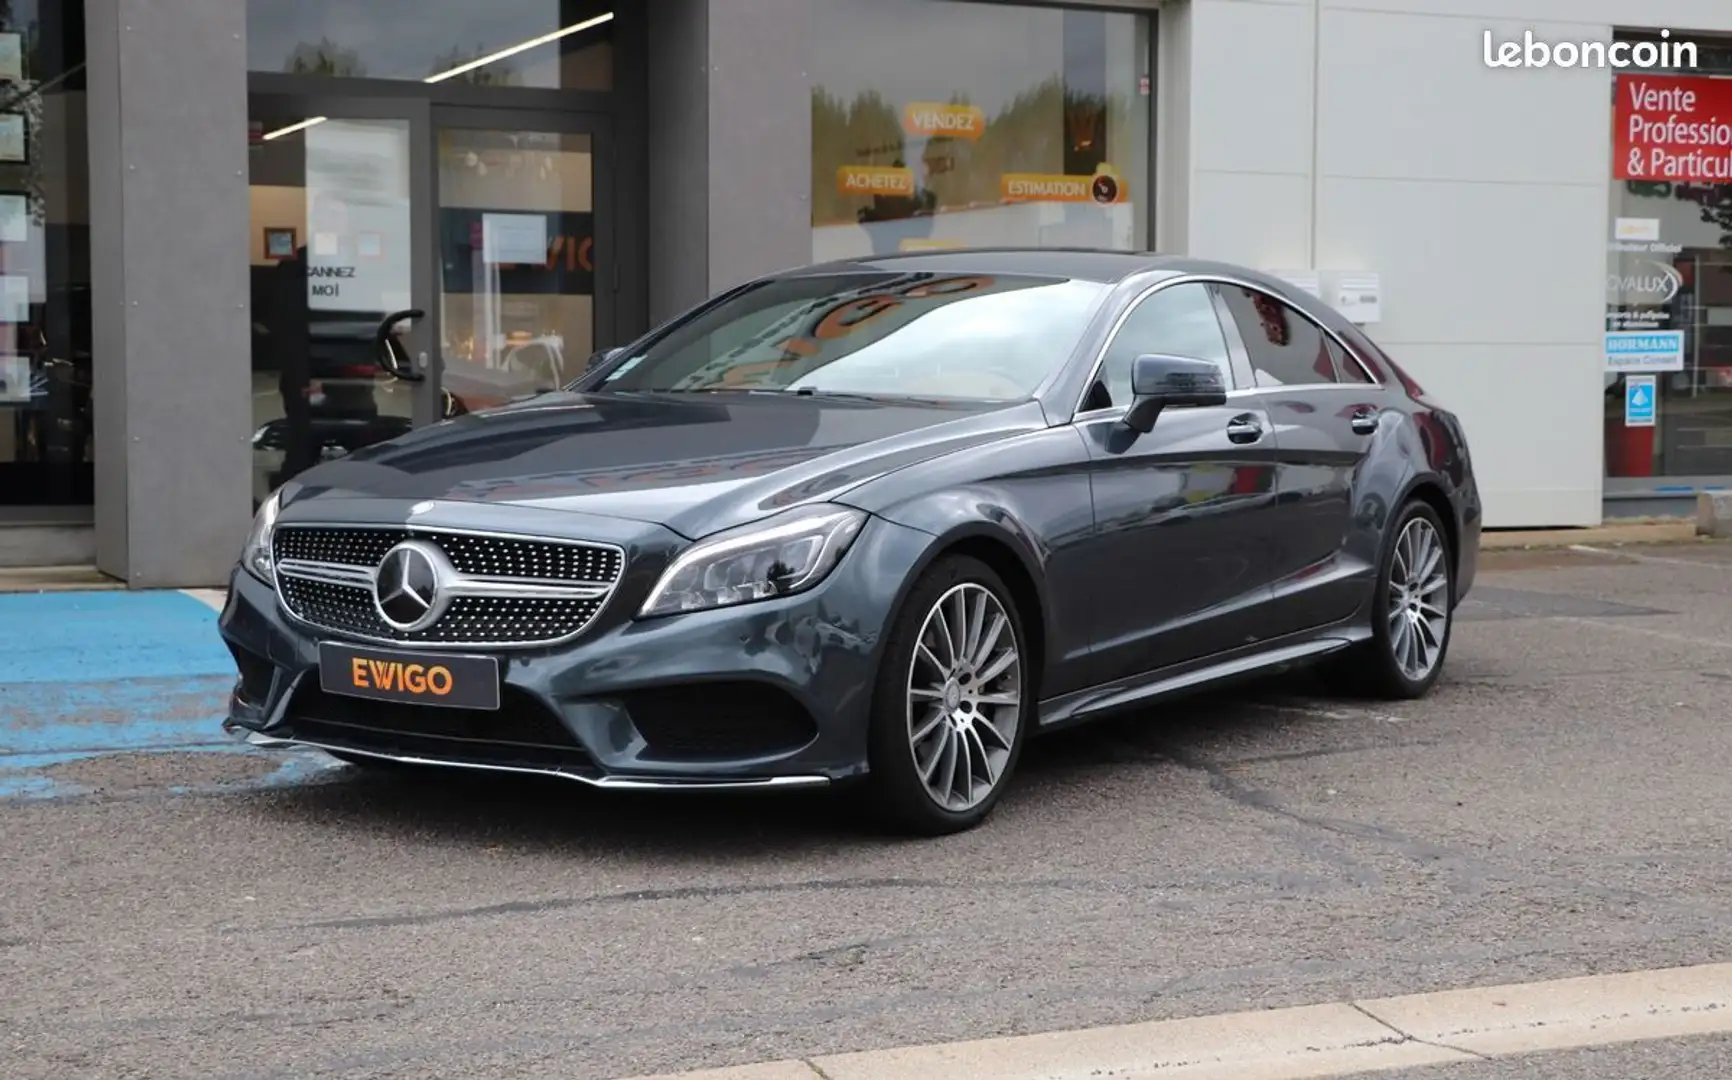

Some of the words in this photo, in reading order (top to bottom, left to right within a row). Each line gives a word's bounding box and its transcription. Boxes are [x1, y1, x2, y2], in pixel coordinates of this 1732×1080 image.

[1629, 81, 1696, 112] Vente
[912, 110, 976, 130] VENDEZ
[1629, 114, 1732, 145] Professio
[1627, 147, 1645, 176] &
[846, 173, 907, 189] ACHETEZ
[1008, 180, 1086, 197] ESTIMATION
[300, 266, 356, 278] CANNEZ
[352, 657, 453, 695] EWIGO
